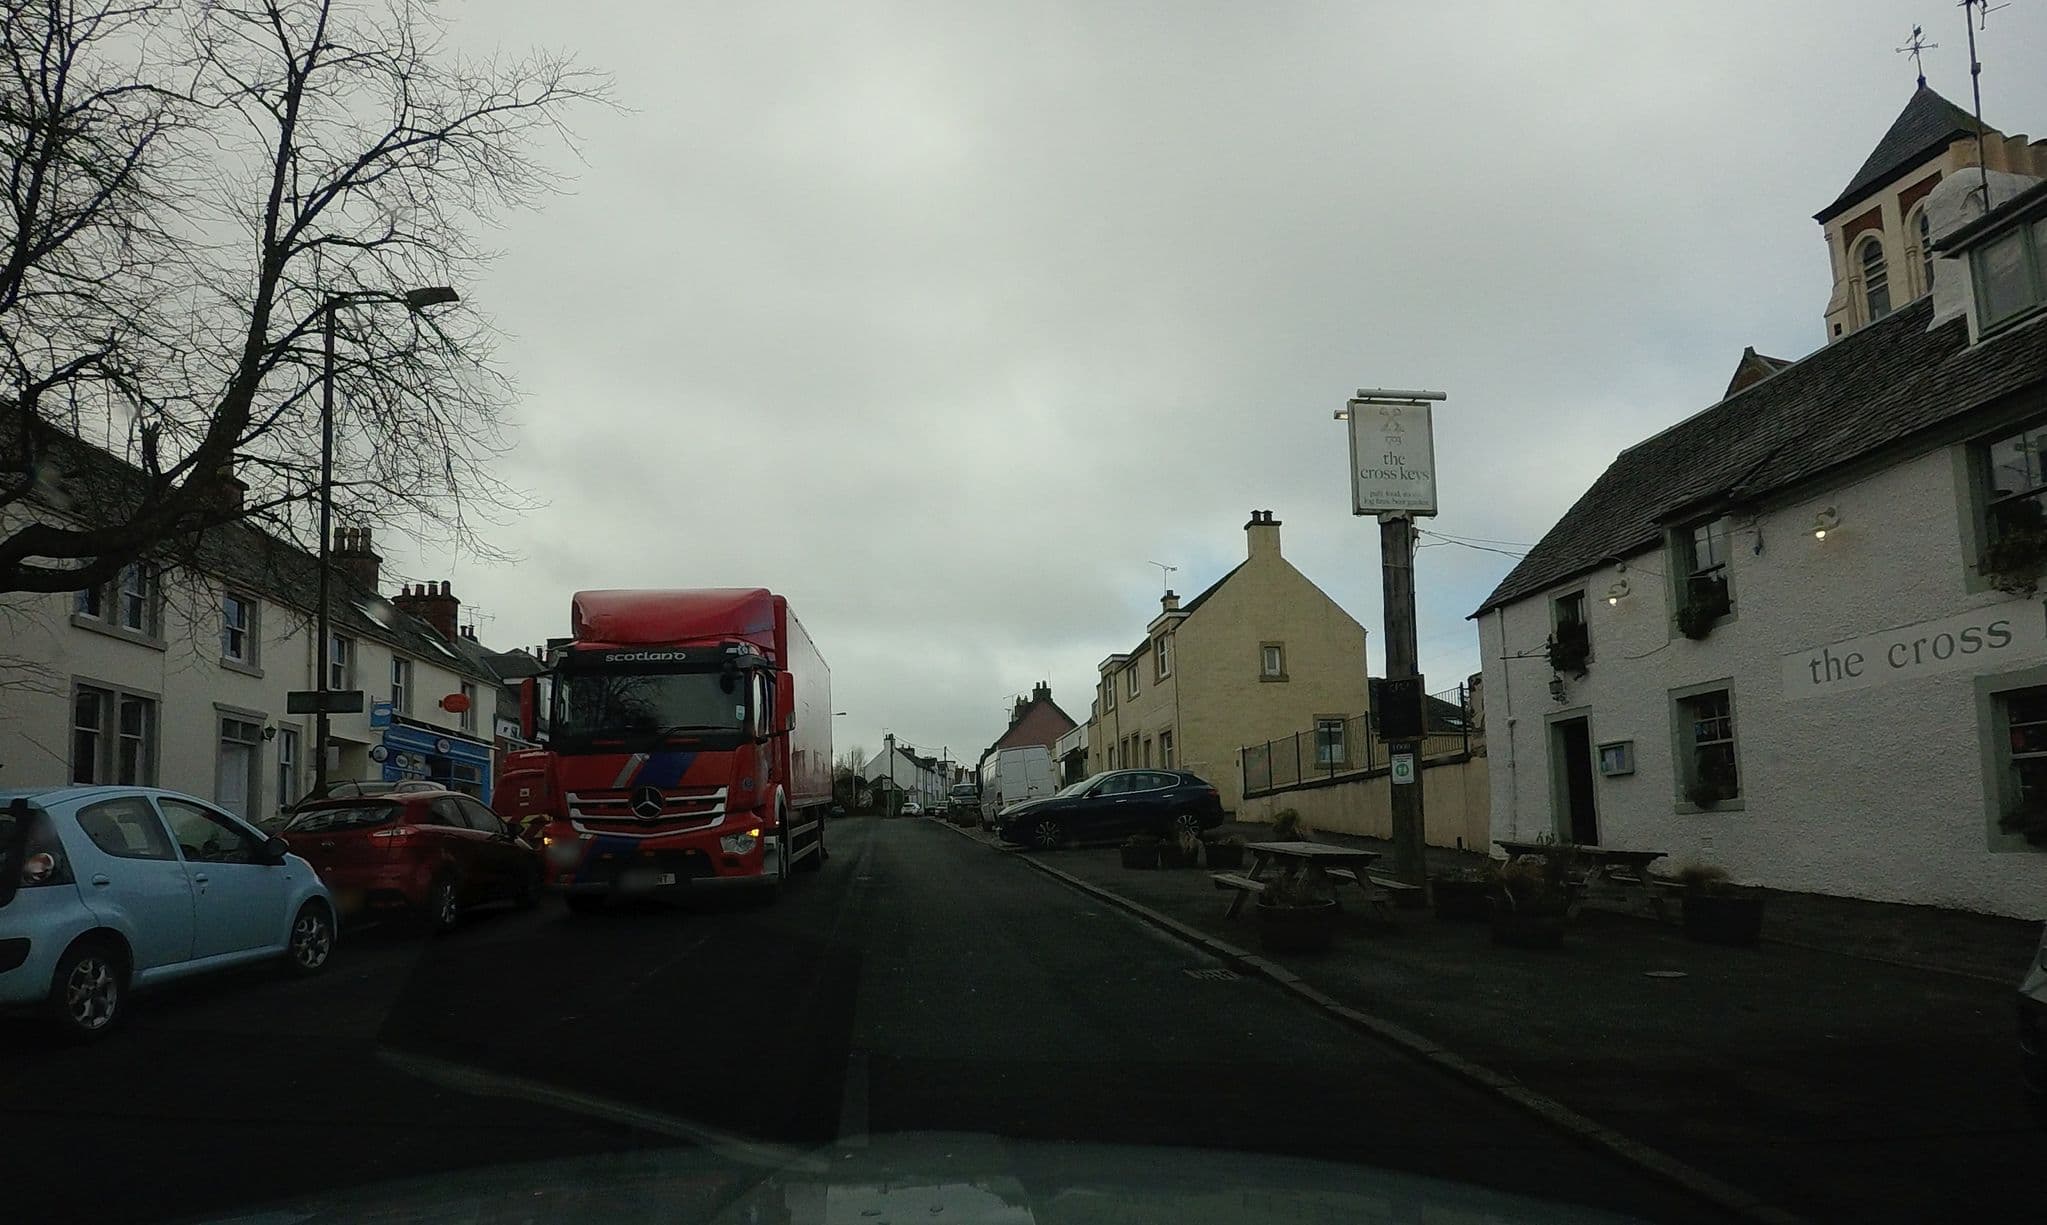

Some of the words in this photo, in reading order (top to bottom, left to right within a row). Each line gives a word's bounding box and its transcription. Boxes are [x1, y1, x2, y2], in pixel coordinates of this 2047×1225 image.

[1383, 451, 1406, 466] the
[1360, 469, 1398, 480] cross
[1400, 466, 1430, 481] keys
[605, 651, 686, 662] scotland
[1808, 648, 1864, 684] the
[1887, 620, 2013, 669] cross
